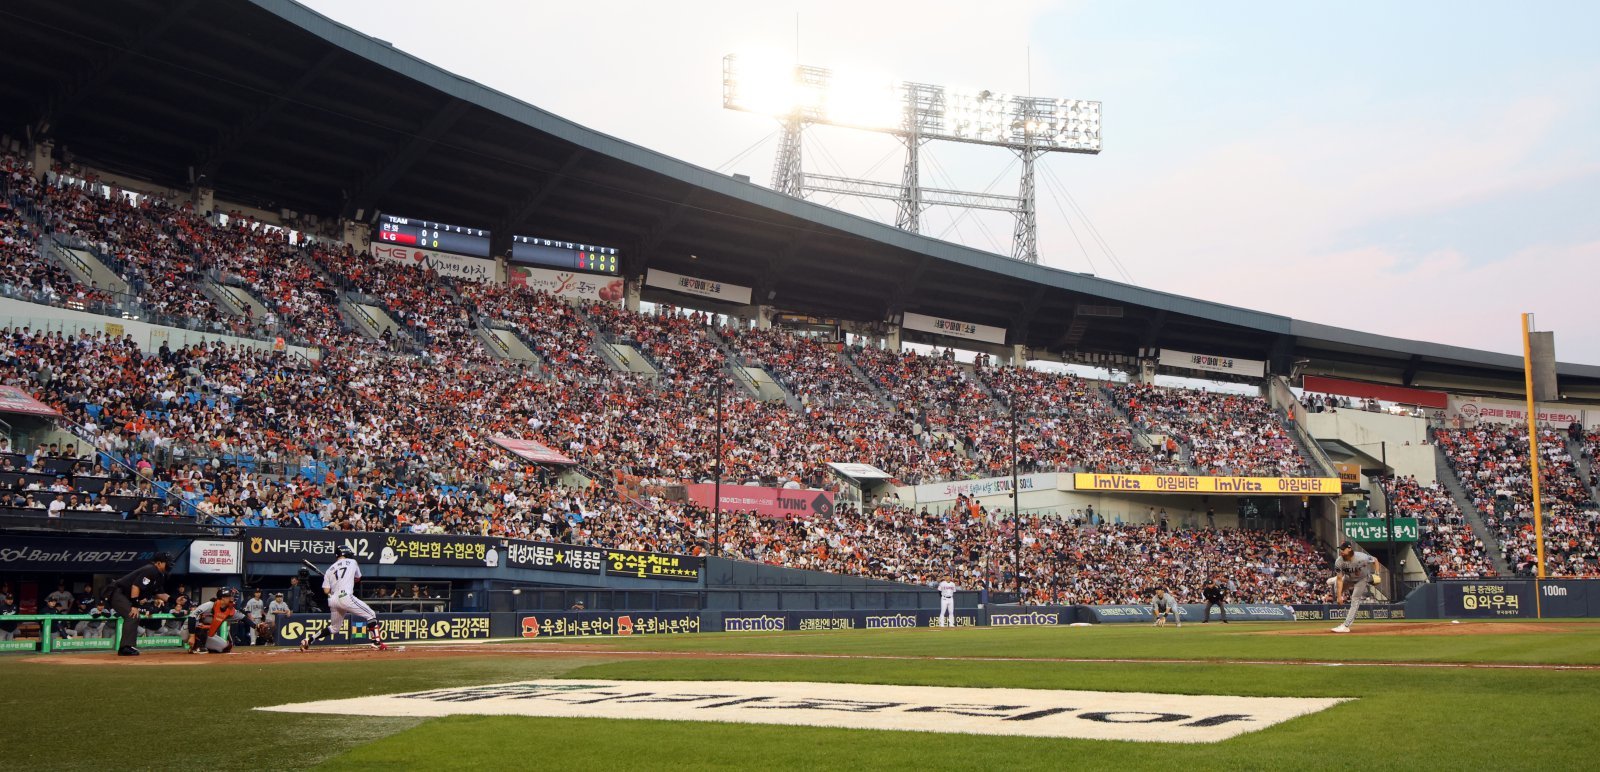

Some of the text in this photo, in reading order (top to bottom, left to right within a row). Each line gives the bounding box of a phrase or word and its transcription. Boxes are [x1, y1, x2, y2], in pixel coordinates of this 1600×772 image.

[383, 223, 399, 232] 한화
[389, 216, 408, 225] TEAM
[422, 229, 438, 239] 0 0
[421, 238, 438, 248] 0 0
[375, 246, 407, 259] MG
[580, 252, 585, 260] 0
[590, 253, 595, 261] 0
[610, 256, 616, 264] 0
[579, 260, 585, 268] 0
[599, 263, 605, 271] 0
[610, 264, 615, 272] 0
[554, 273, 577, 294] Yes
[1156, 476, 1199, 490] 아임비타
[1278, 478, 1322, 492] 아임비타
[776, 498, 807, 510] TVING
[264, 539, 335, 553] NH투자증권
[386, 536, 486, 560] Sh 수협보험 수협은행
[27, 549, 72, 561] Bank
[72, 551, 138, 562] KBO리그
[508, 543, 601, 570] 태성자동문 자동중문
[608, 552, 679, 578] 장수돌침대
[333, 567, 347, 580] 17
[1542, 585, 1567, 596] 100m
[1478, 595, 1519, 609] 와우퀵
[540, 615, 700, 636] 육회바른연어 육회바른연어
[725, 615, 785, 632] mentos
[832, 618, 856, 629] 언제나
[866, 613, 917, 629] mentos
[991, 612, 1058, 626] mentos
[368, 618, 428, 641] 강펜테리움
[451, 618, 490, 638] 금강주택
